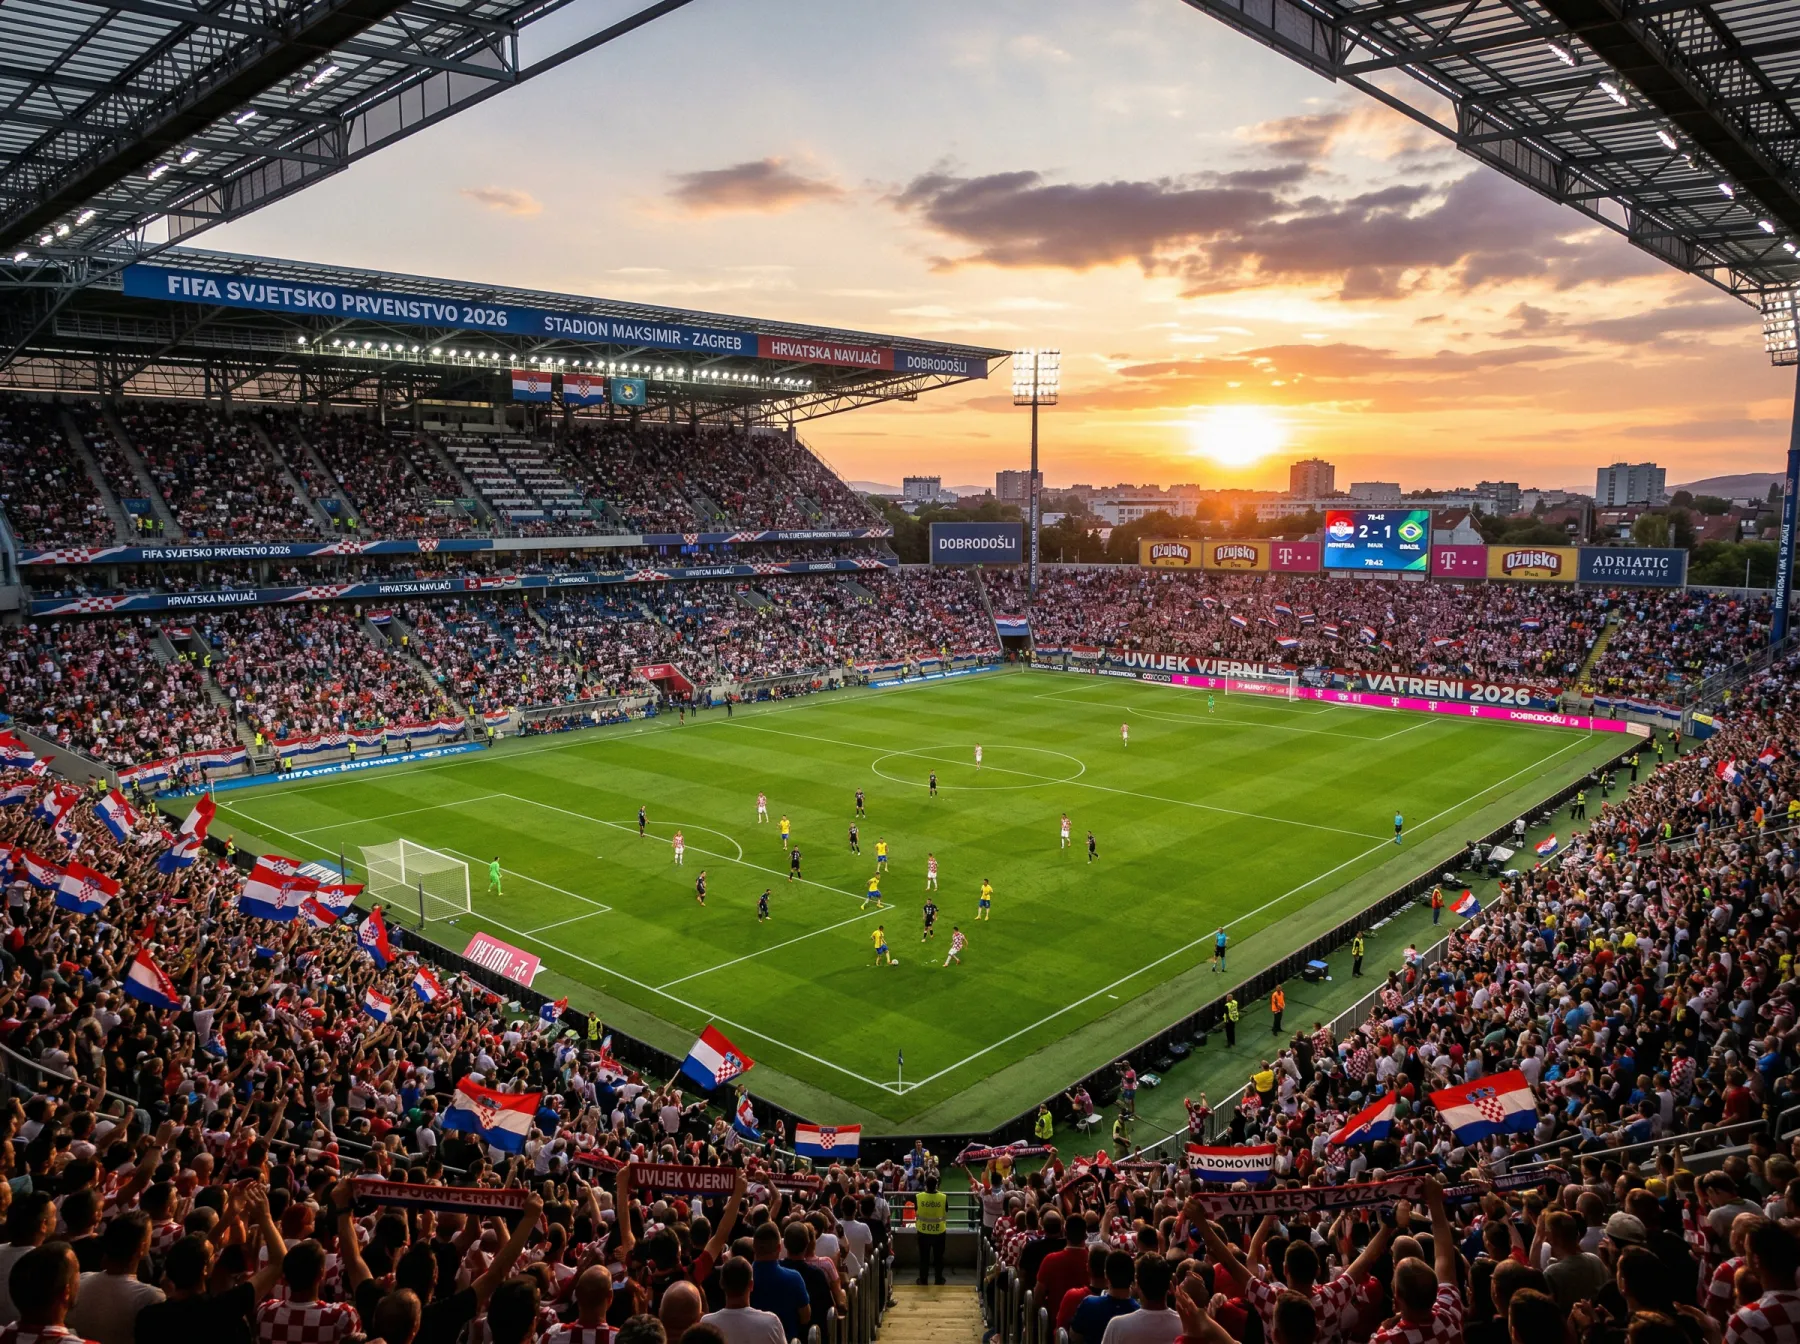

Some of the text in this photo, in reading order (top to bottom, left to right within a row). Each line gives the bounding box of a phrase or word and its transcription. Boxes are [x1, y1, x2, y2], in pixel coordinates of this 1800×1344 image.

[168, 275, 508, 327] FIFA SVJETSKO PRVENSTVO 2026
[544, 316, 608, 337] STADION
[612, 324, 681, 344] MAKSIMIR
[692, 333, 742, 350] ZAGREB
[771, 341, 881, 365] HRVATSKA NAVIJAČI
[907, 355, 967, 373] DOBRODOŠLI
[1359, 525, 1369, 538] 2
[1384, 525, 1391, 539] 1
[939, 534, 1015, 550] DOBRODOŠLI
[142, 546, 291, 559] FIFA SVJETSKO PRVENSTVO 2026
[1592, 556, 1669, 569] ADRIATIC
[1592, 568, 1669, 577] OSIGURANJE
[379, 584, 418, 593] HRVATSKA
[167, 594, 216, 606] HRVATSKA
[1124, 651, 1190, 673] UVIJEK
[1195, 658, 1264, 679] VJERNI
[1365, 673, 1530, 706] VATRENI 2026
[1189, 1155, 1273, 1169] ZA DOMOVINU
[637, 1168, 734, 1189] UVIJEK VJERNI
[1227, 1187, 1388, 1212] VATRENI 2026
